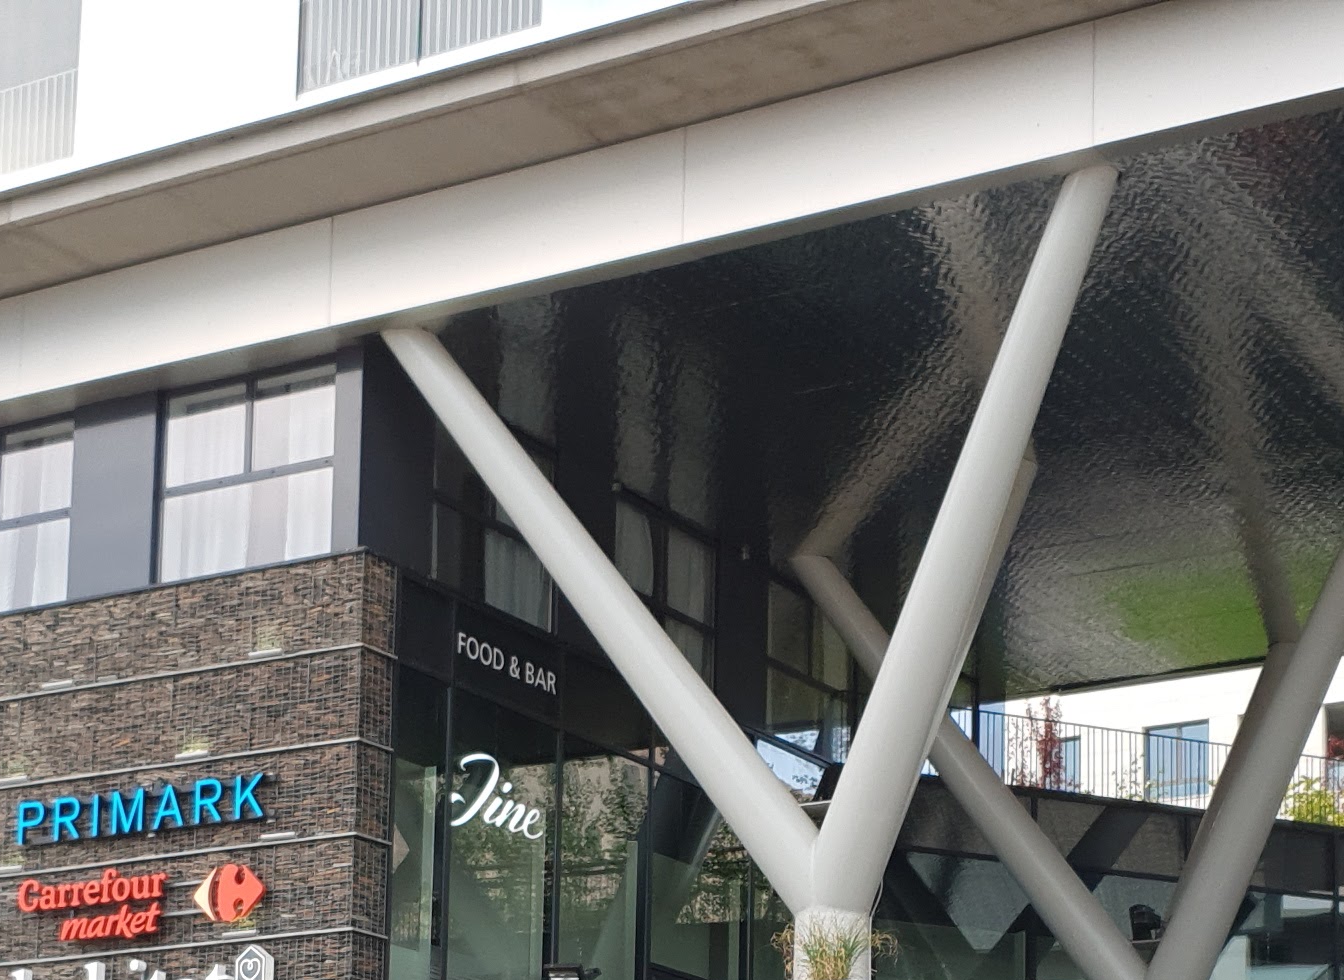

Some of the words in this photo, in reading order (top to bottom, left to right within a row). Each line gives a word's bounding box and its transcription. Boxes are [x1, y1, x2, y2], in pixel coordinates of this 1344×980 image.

[457, 632, 505, 671] FOOD
[509, 655, 521, 680] &
[525, 661, 557, 695] BAR
[16, 773, 265, 846] PRIMARK
[17, 868, 168, 913] Carrefour
[60, 902, 162, 942] market
